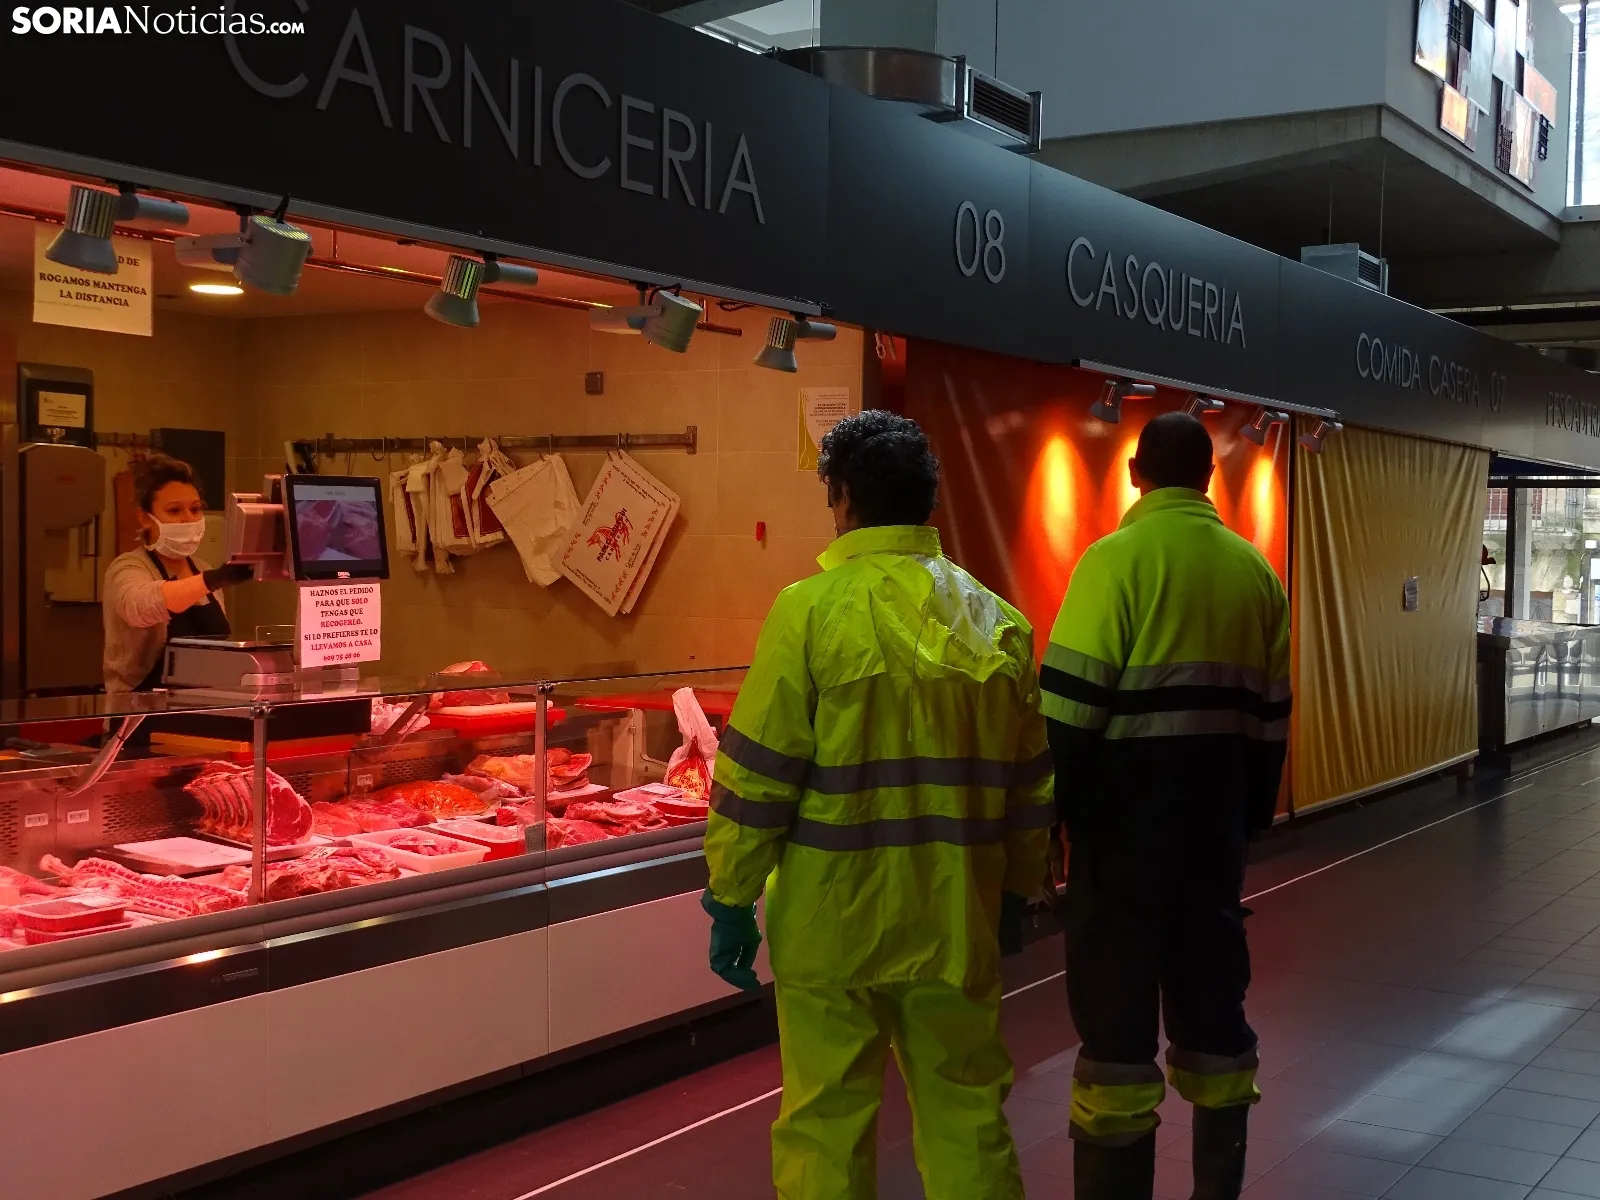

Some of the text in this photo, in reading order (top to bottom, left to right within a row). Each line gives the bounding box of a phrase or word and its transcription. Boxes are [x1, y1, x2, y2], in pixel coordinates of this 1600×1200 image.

[222, 0, 766, 225] CARNICERIA
[126, 256, 140, 267] DE
[955, 200, 1247, 349] 08 CASQUERIA
[39, 272, 148, 296] ROGAMOS MANTENGA
[59, 289, 130, 307] LA DISTANCIA
[1356, 332, 1508, 413] COMIDA CASERA 07
[310, 588, 339, 597] HAZNOS
[349, 587, 374, 595] PEDIDO
[336, 599, 350, 607] QUE
[320, 608, 364, 617] TENGAS QUE
[320, 619, 363, 628] RECOGERLO.
[322, 630, 359, 640] PREFIERES
[311, 641, 347, 651] LLEVAMOS
[354, 639, 373, 647] CASA
